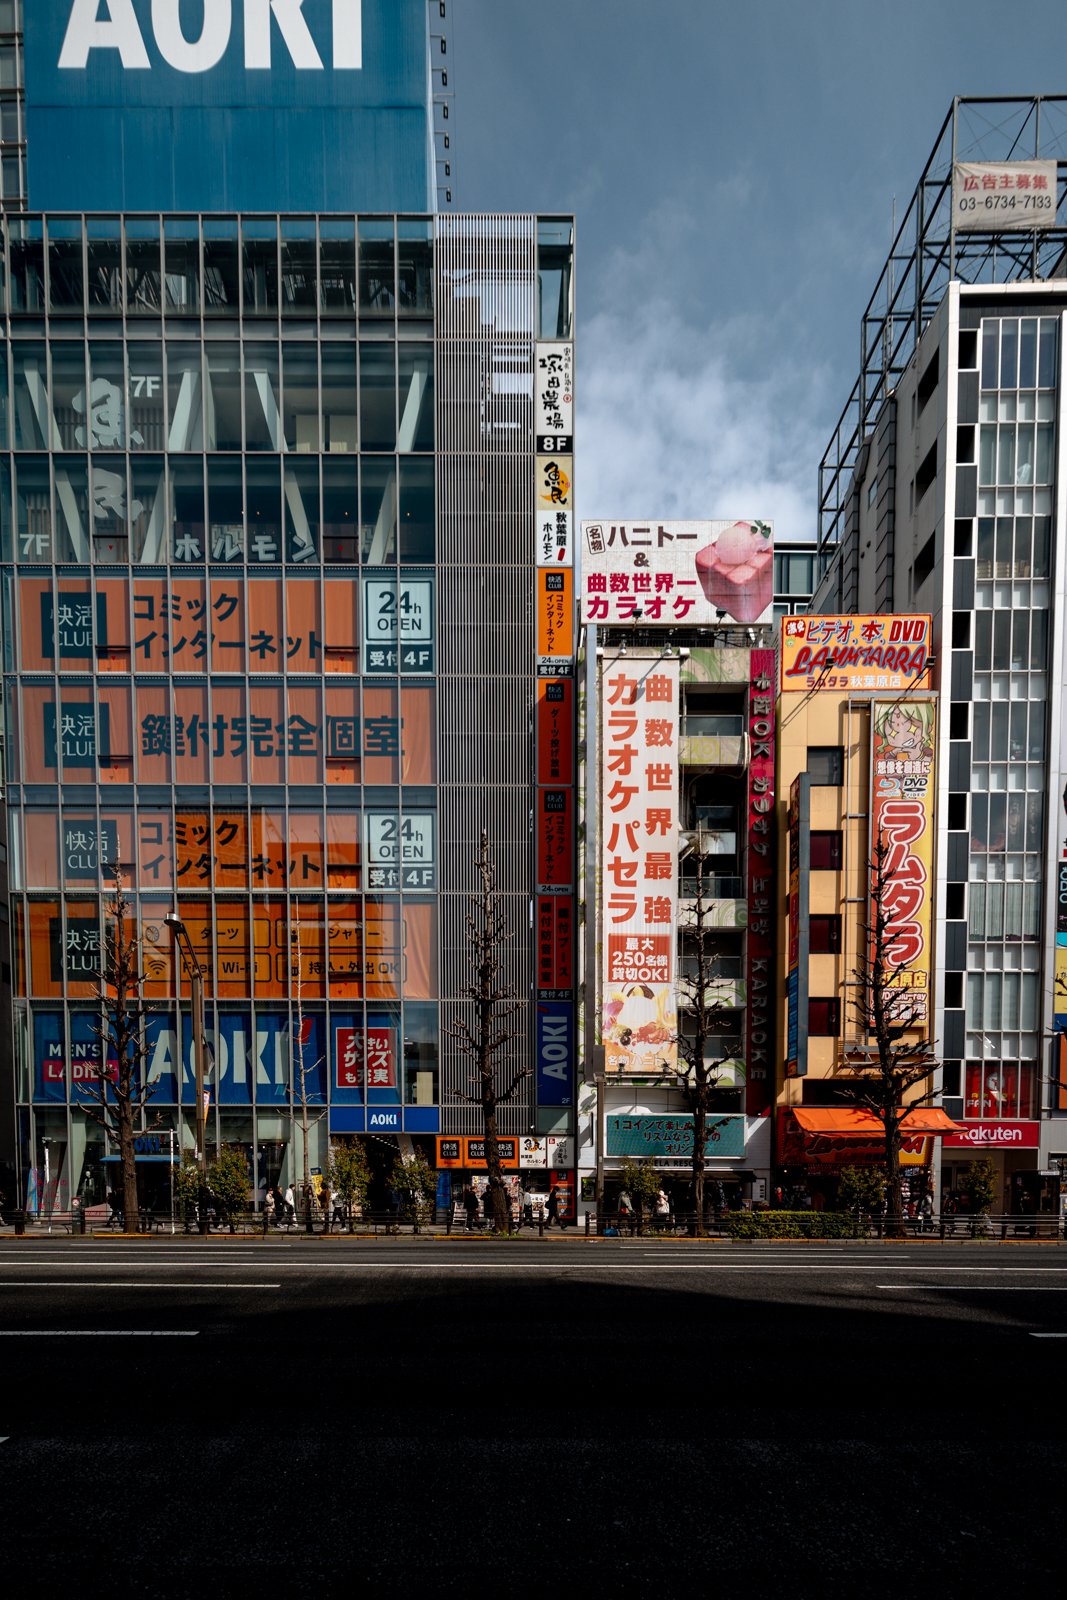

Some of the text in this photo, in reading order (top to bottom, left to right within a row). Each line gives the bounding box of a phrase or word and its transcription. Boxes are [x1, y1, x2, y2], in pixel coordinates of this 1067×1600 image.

[58, 0, 362, 73] AOKI
[963, 174, 1048, 192] 広告主募集
[959, 195, 1052, 211] 03-6734-7133
[130, 376, 161, 398] 7F
[543, 437, 567, 451] 8F
[556, 512, 567, 546] 秋葉原
[588, 527, 603, 551] 名物
[607, 526, 698, 547] ハニトー
[20, 533, 50, 555] 7F
[174, 533, 316, 563] ホルモン
[543, 522, 553, 560] ホルモン
[633, 552, 650, 568] &
[587, 573, 697, 593] 曲数世界一
[134, 593, 239, 621] コミック
[378, 591, 422, 614] 24h
[556, 594, 564, 628] コミック
[586, 595, 696, 620] カラオケ
[50, 604, 94, 627] 快活
[377, 618, 422, 630] OPEN
[546, 594, 554, 652] インターネット
[52, 630, 96, 647] CLUB
[133, 631, 322, 659] インターネット
[370, 651, 430, 667] 受付 4F
[785, 646, 927, 678] LAMMTARRA
[540, 666, 570, 675] 受付 4F
[806, 675, 902, 688] ラムタラ 秋葉原店
[52, 714, 96, 737] 快活
[141, 714, 405, 757] 鍵付完全個室
[54, 740, 98, 757] CLUB
[607, 674, 640, 923] カラオケパセラ
[644, 674, 673, 924] 曲数世界最強
[141, 820, 239, 846] コミック
[380, 818, 424, 841] 24h
[556, 816, 565, 855] コミック
[65, 830, 108, 852] 快活
[379, 845, 424, 858] OPEN
[545, 815, 554, 881] インターネット
[67, 854, 109, 870] CLUB
[142, 855, 321, 880] インターネット
[370, 869, 433, 886] 受付 4F
[879, 800, 926, 969] ラムタラ
[58, 929, 102, 951] 快活
[201, 928, 239, 939] ダーツ
[328, 928, 380, 940] シャワー
[626, 937, 654, 950] 最大
[183, 962, 214, 974] Free
[612, 952, 668, 966] 250名様
[751, 958, 767, 1080] KARAOKE
[346, 1032, 388, 1050] 大きい
[541, 1016, 568, 1081] AOKI
[146, 1030, 290, 1085] AOKI
[344, 1050, 392, 1067] サイズ
[345, 1068, 389, 1083] も充実
[370, 1114, 397, 1125] AOKI
[133, 1138, 161, 1153] OKI
[443, 1143, 457, 1151] 快活
[470, 1143, 485, 1151] 快活
[498, 1143, 512, 1151] 快活
